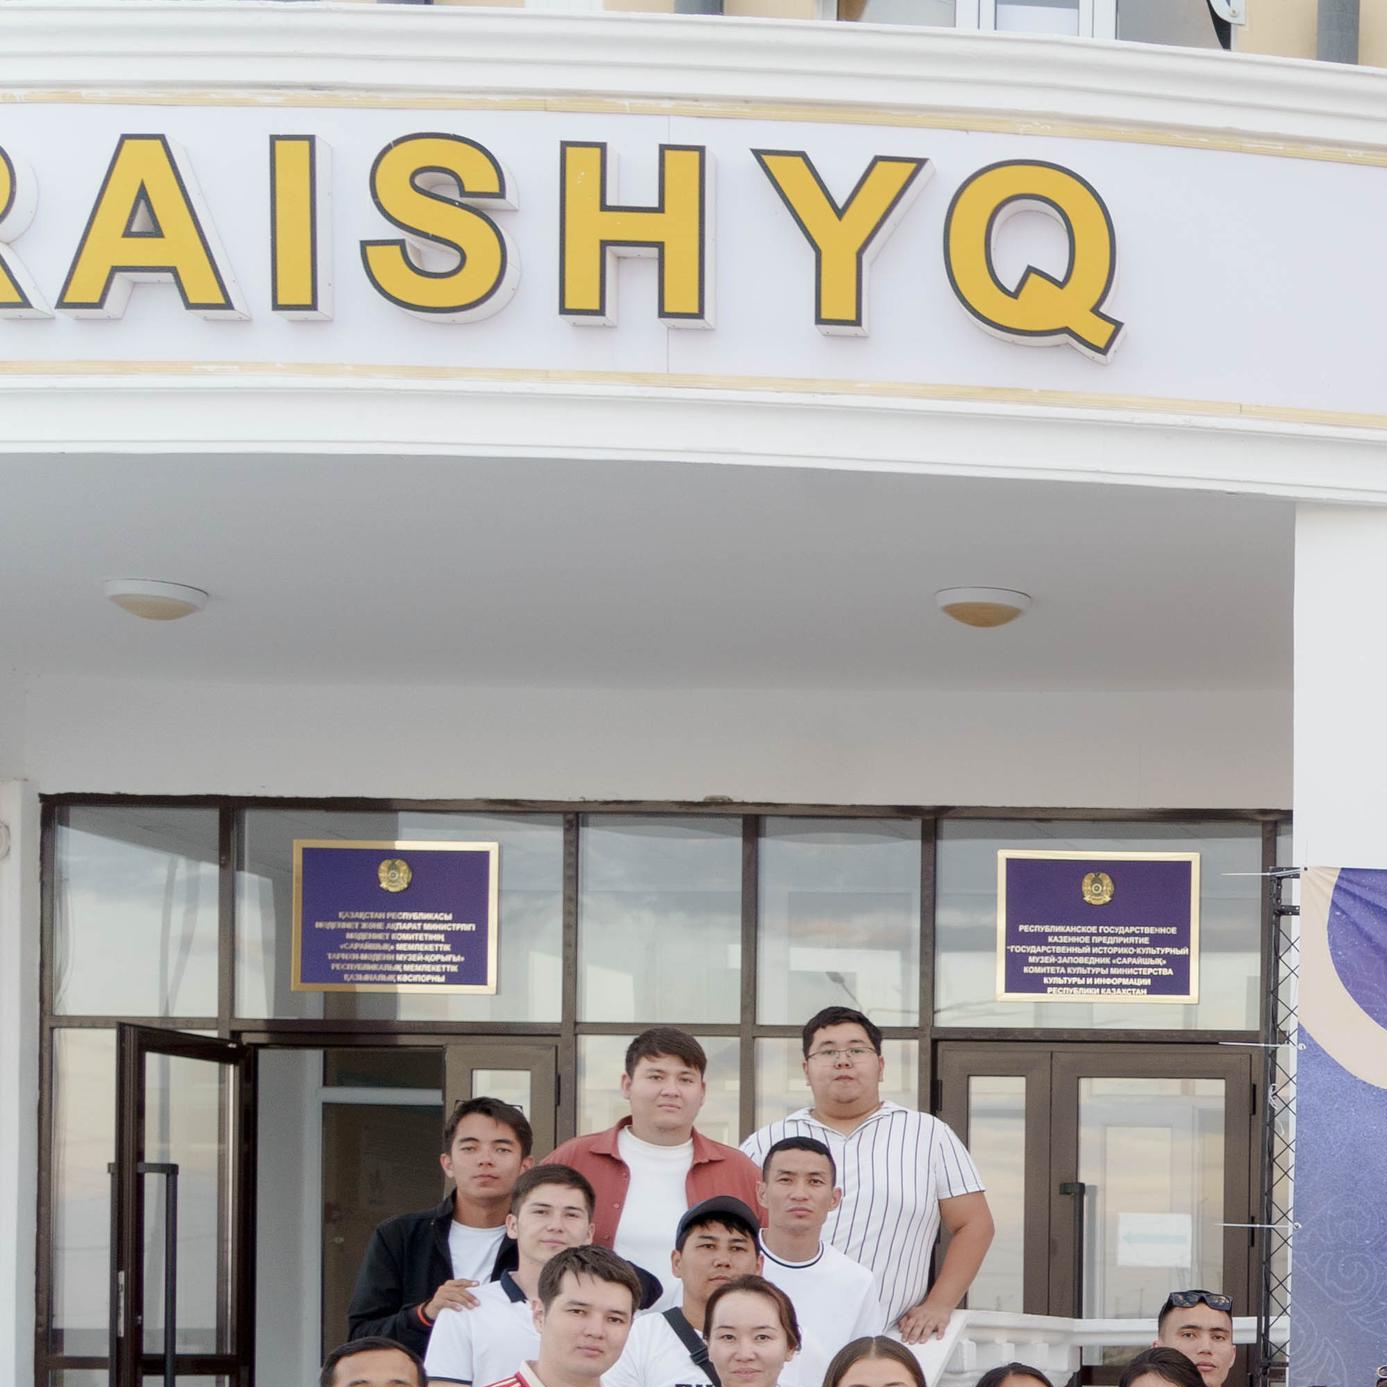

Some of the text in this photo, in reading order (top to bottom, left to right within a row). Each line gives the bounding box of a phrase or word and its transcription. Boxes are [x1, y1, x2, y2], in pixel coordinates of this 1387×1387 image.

[1019, 925, 1177, 935] РЕСПУБЛИКАНСКОЕ ГОСУДАРСТВЕННОЕ
[1048, 935, 1150, 944] КАЗЕННОЕ ПРЕДПРИЯТИЕ
[1092, 946, 1189, 955] ИСТОРИКО-КУЛЬТУРНЫЙ
[1028, 955, 1111, 964] МУЗЕЙ-ЗАПОВЕДНИК
[1023, 966, 1174, 976] КОМИТЕТА КУЛЬТУРЫ МИНИСТЕРСТВА
[1043, 976, 1151, 986] КУЛЬТУРЫ И ИНФОРМАЦИИ
